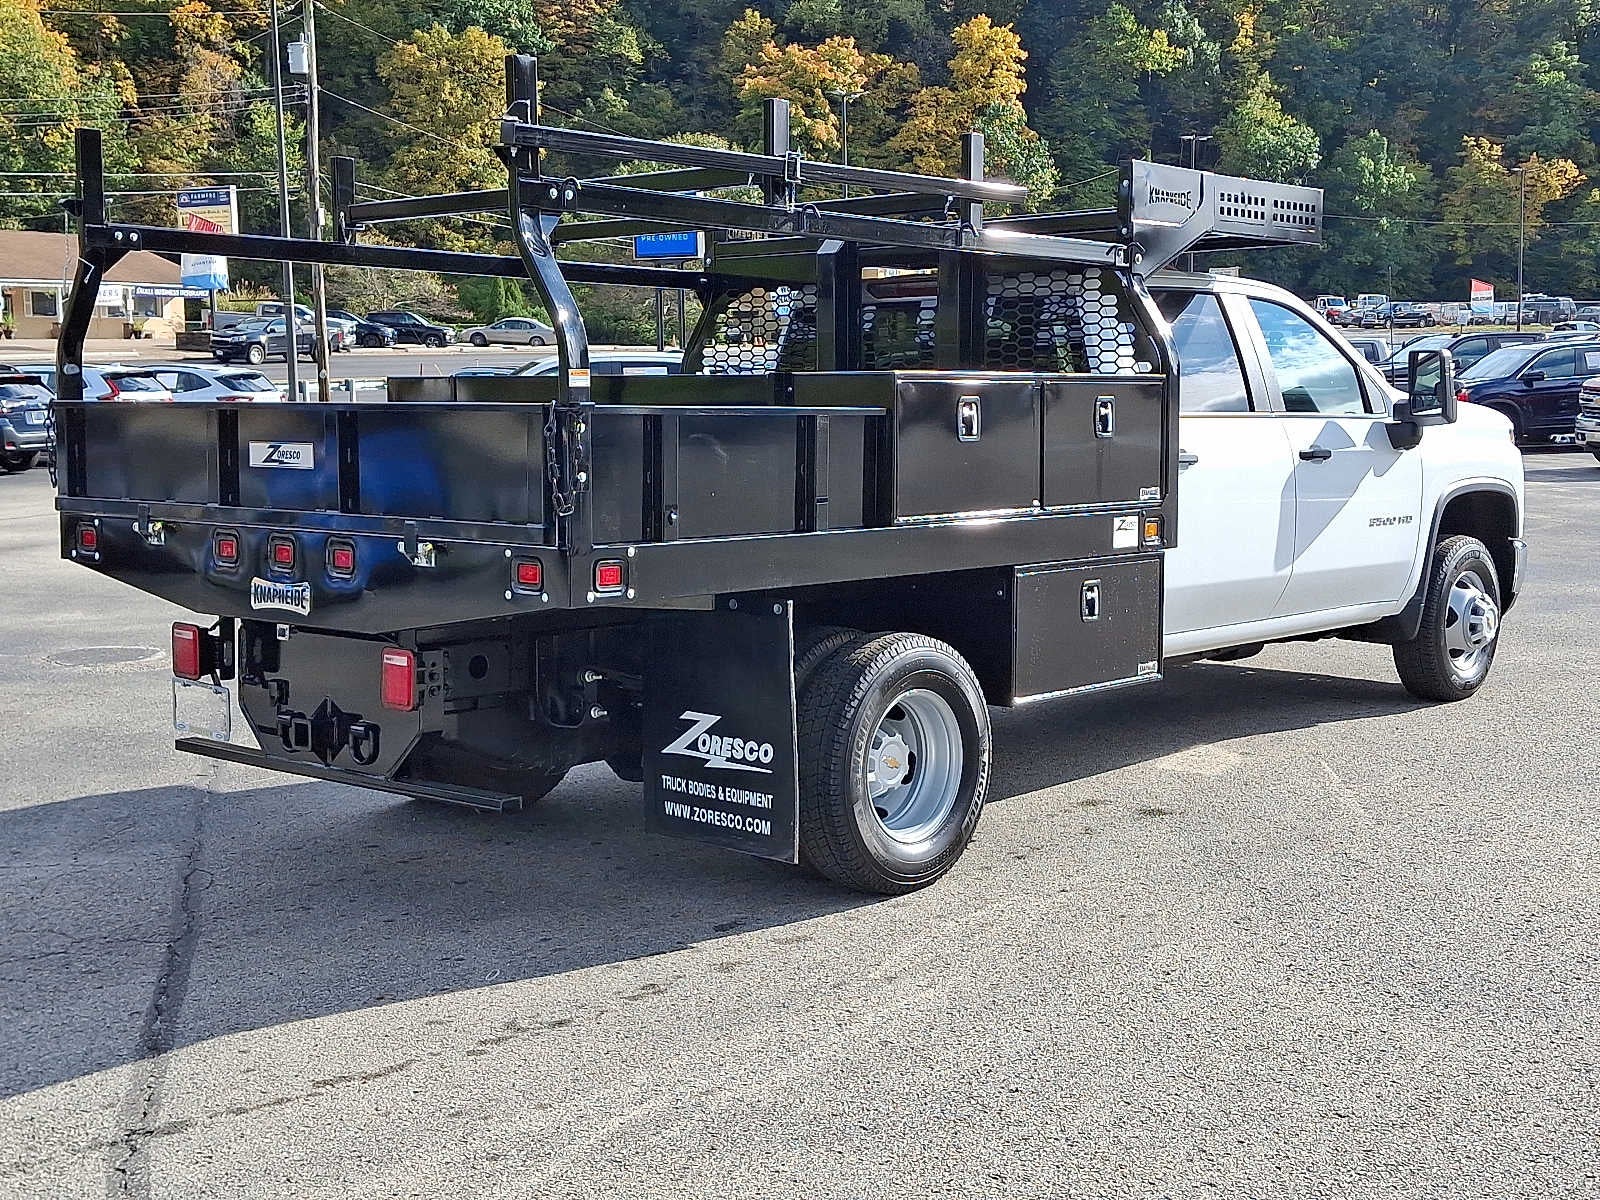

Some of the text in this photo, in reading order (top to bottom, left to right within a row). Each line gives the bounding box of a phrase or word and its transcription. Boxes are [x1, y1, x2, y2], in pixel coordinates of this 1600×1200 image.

[191, 192, 216, 200] FARMERS
[1149, 184, 1192, 210] KNAPHEIDE
[641, 233, 688, 242] PRE-OWNED
[262, 445, 302, 464] ZORESCO
[253, 582, 308, 610] KNAPHEIDE
[660, 710, 774, 774] ZORESCO
[661, 774, 774, 809] TRUCK BODIES & EQUIPMENT
[664, 800, 771, 836] WWW.ZORESCO.COM
